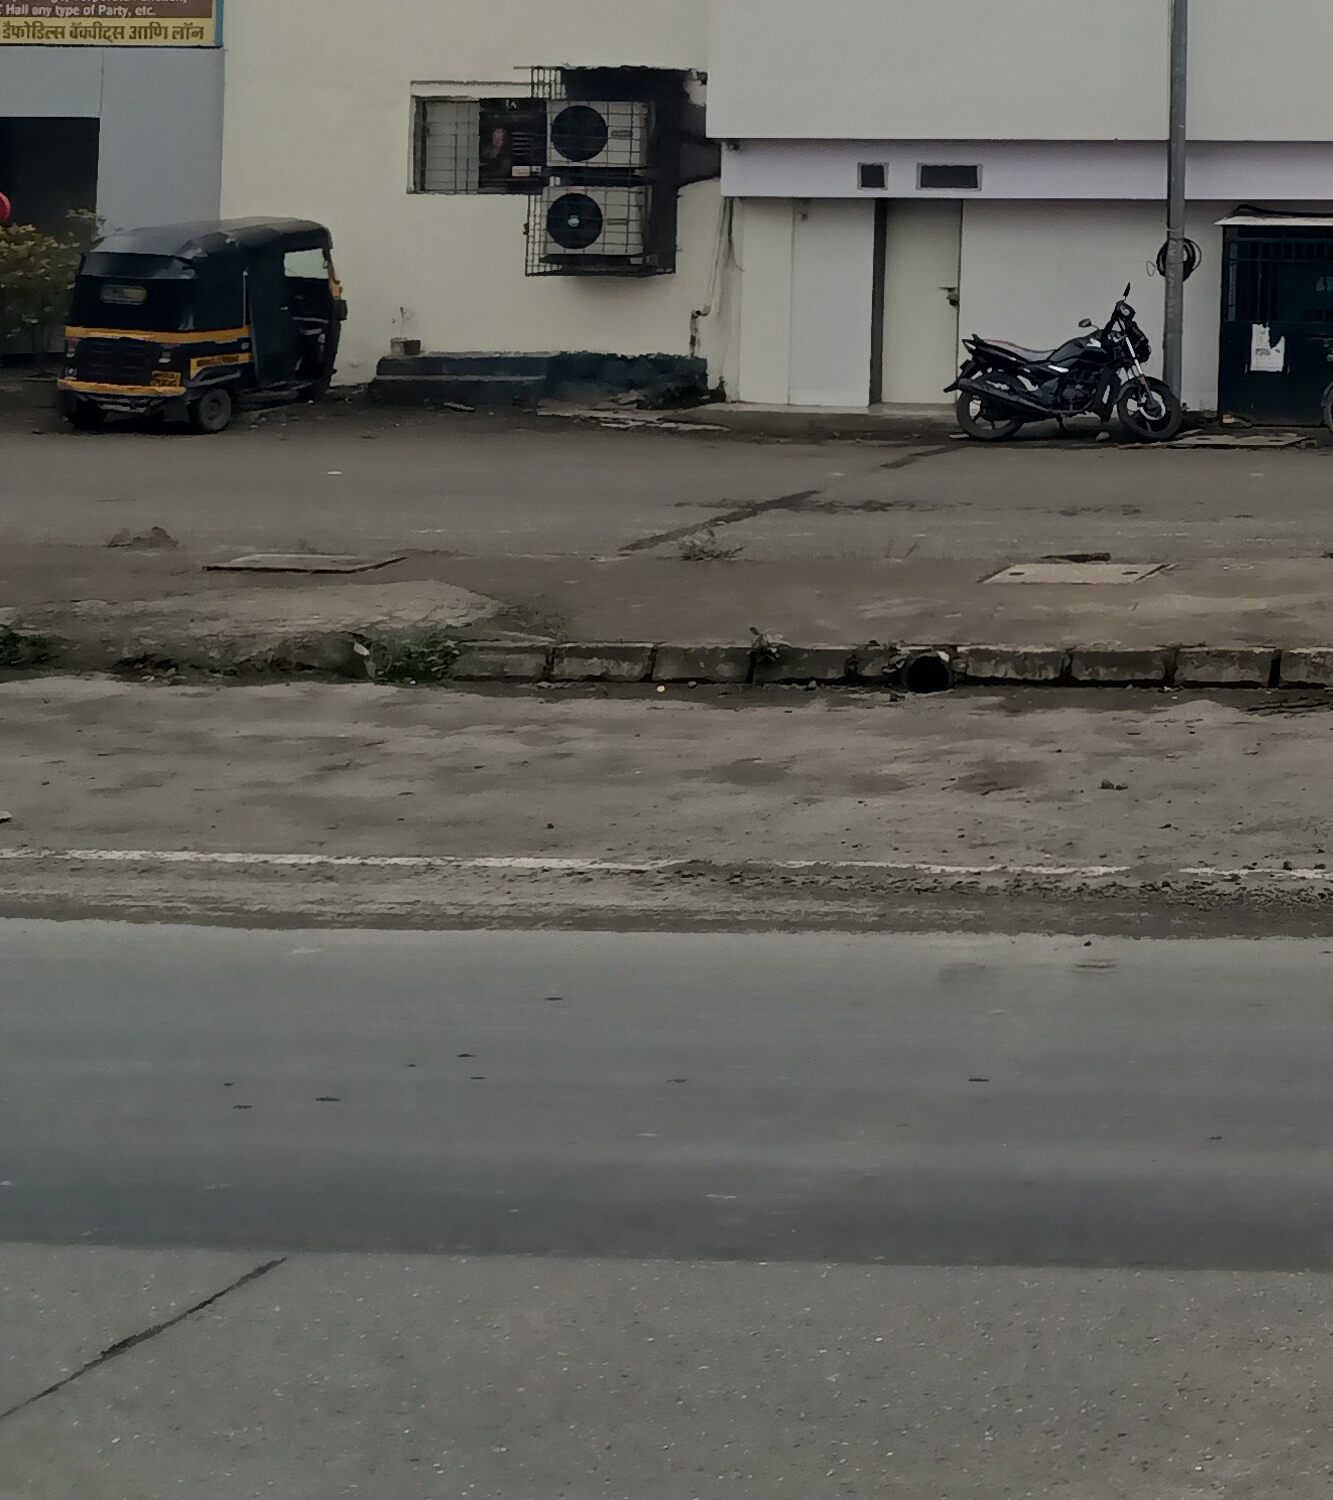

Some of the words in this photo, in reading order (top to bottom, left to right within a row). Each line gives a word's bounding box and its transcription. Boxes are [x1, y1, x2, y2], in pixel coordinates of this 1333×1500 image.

[6, 4, 29, 15] Hall
[32, 6, 52, 17] any
[55, 5, 80, 17] type
[83, 4, 95, 15] of
[99, 4, 131, 18] Party,
[129, 21, 168, 40] आणि
[172, 21, 204, 40] लॉन
